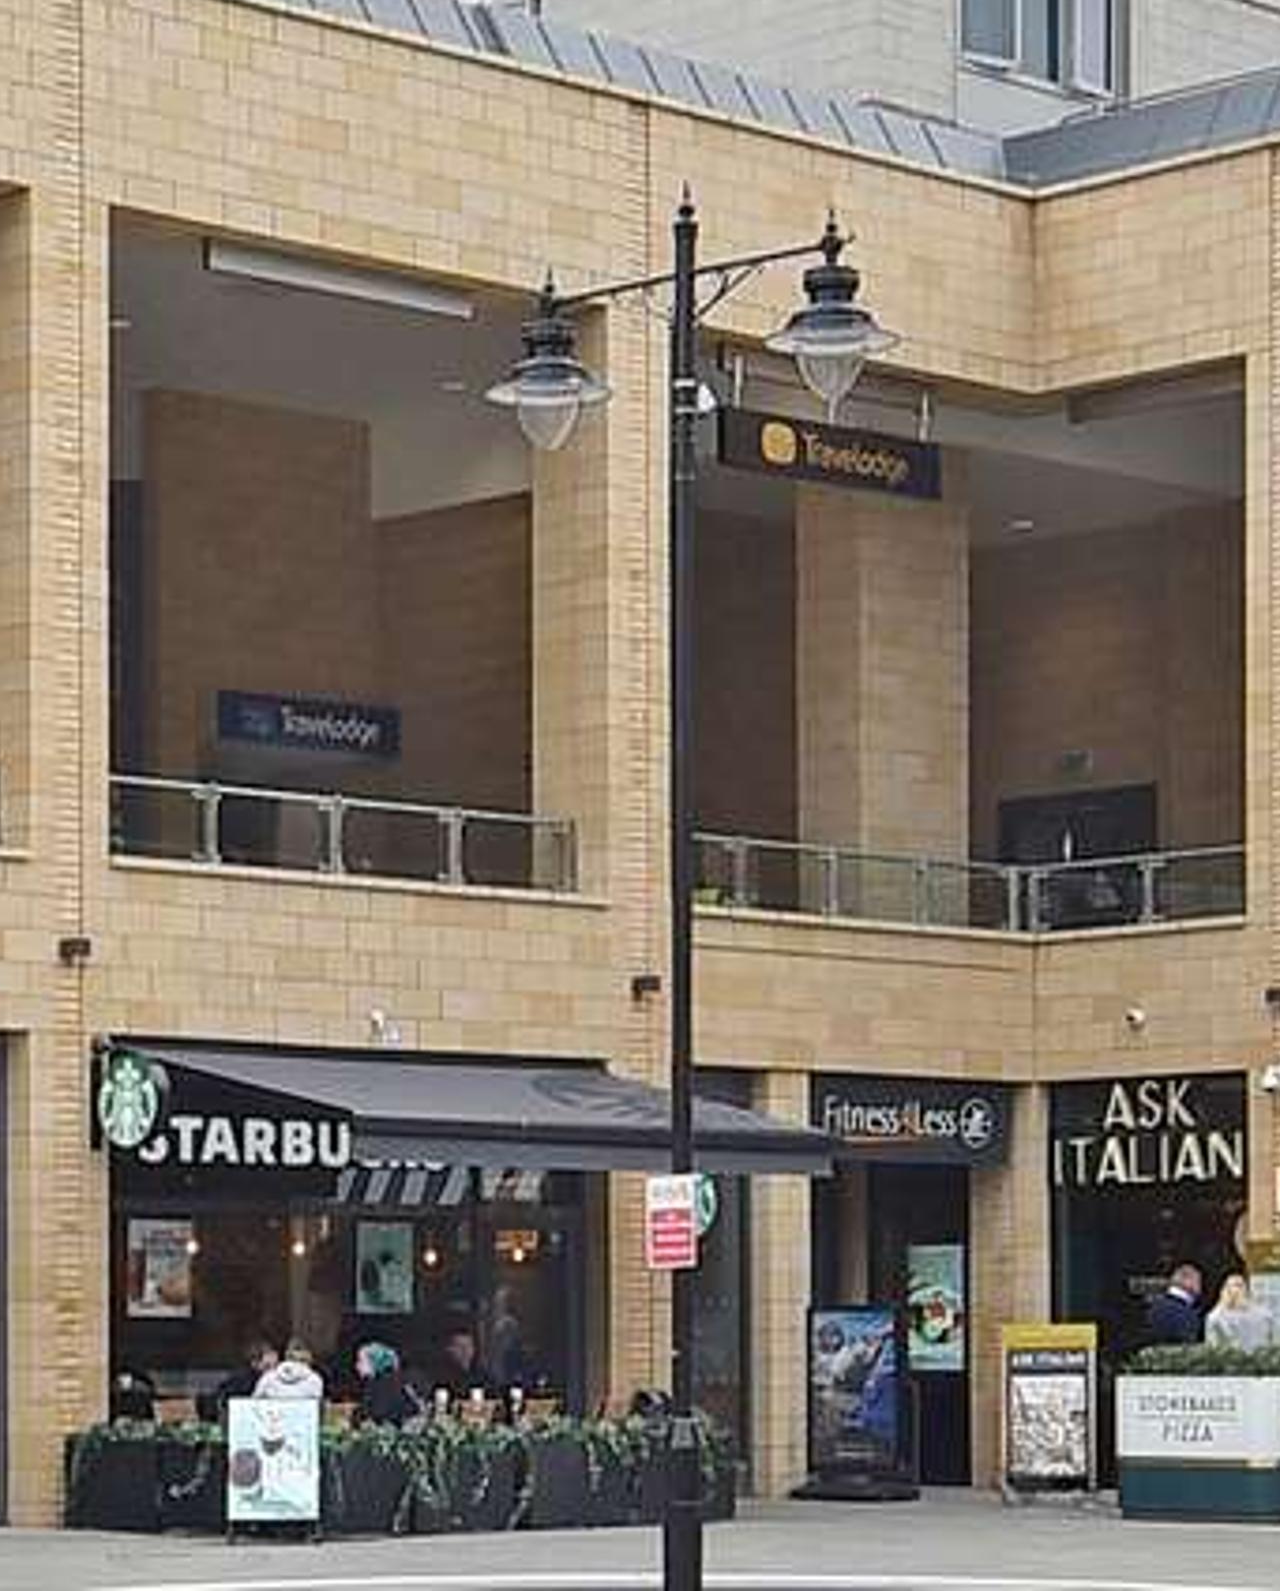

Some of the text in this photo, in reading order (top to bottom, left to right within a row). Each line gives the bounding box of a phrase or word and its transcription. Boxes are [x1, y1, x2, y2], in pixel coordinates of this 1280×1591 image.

[1103, 1080, 1196, 1130] ASK
[138, 1114, 446, 1171] TARBU
[1054, 1128, 1243, 1186] ITALIAN
